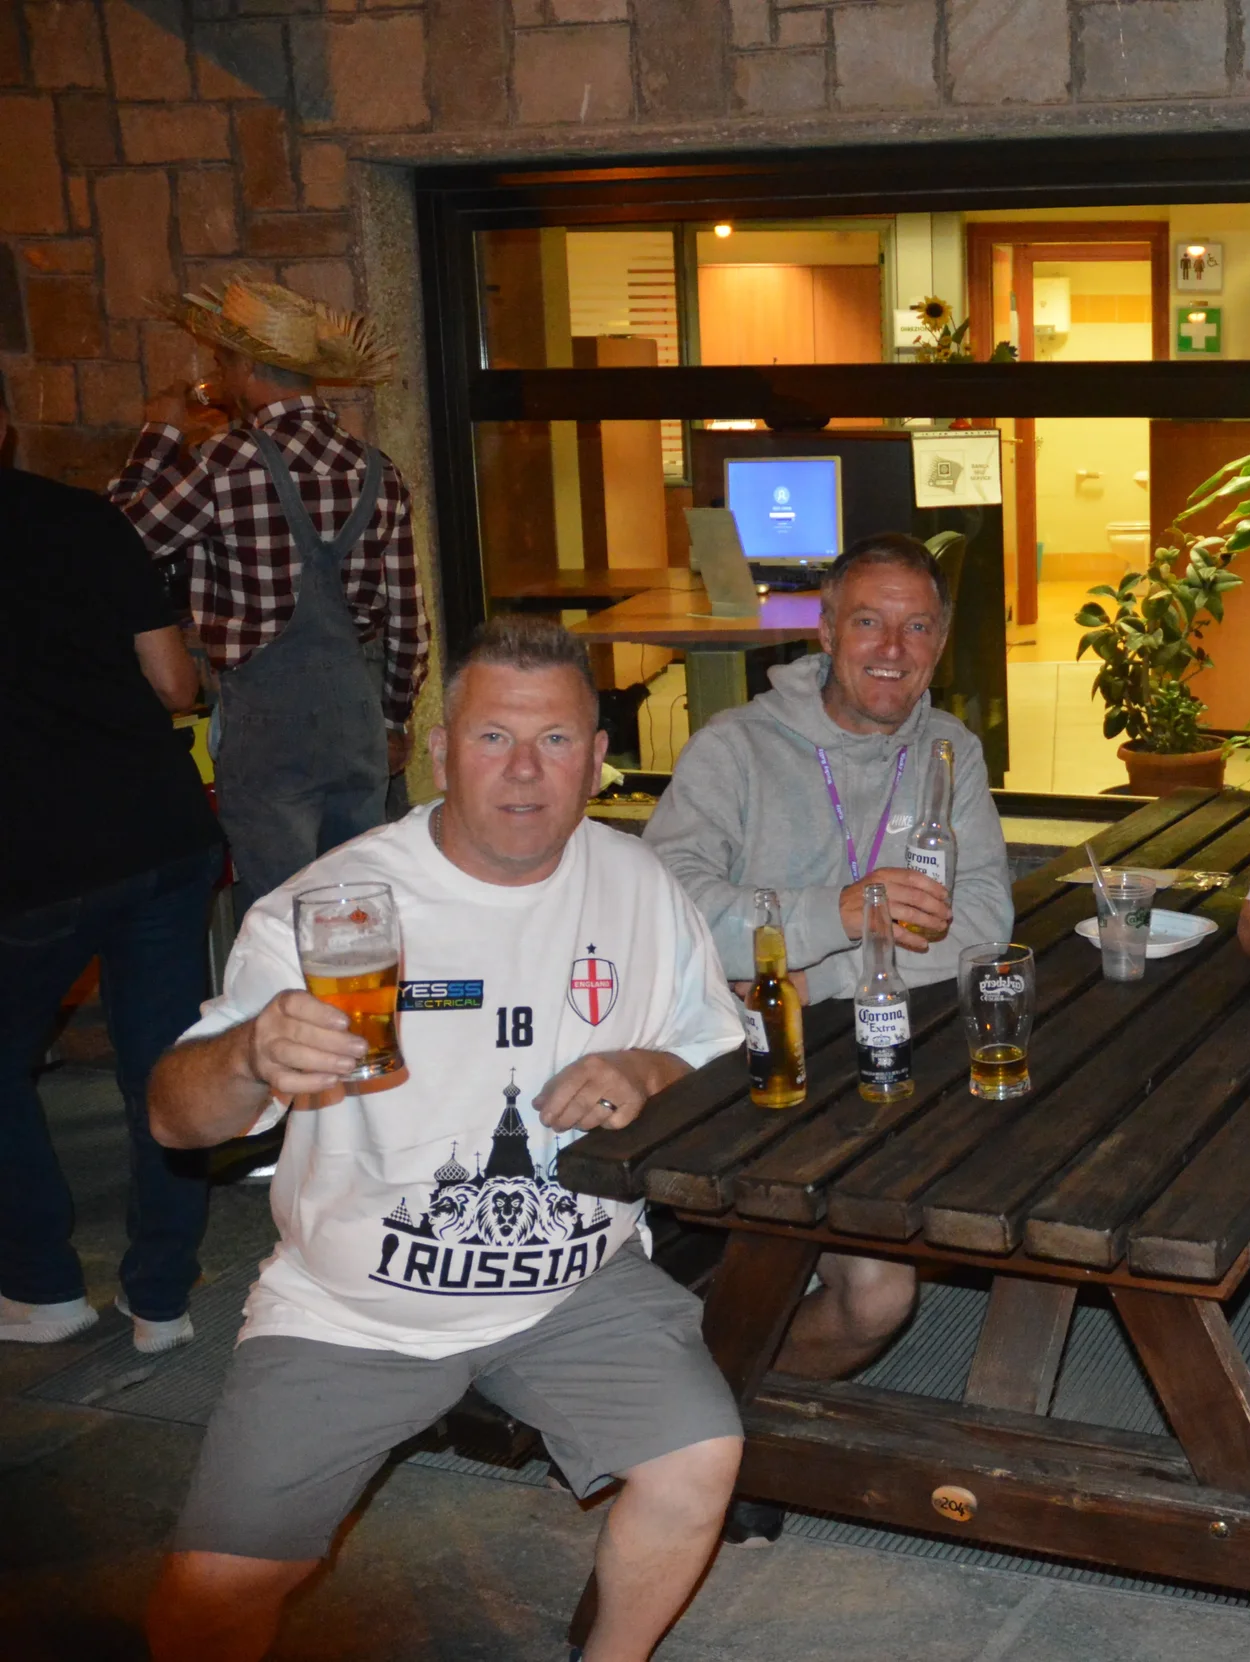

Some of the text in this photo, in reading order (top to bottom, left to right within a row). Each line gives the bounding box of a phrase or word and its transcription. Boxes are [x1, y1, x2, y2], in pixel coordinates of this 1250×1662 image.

[891, 815, 913, 826] NIKE
[398, 983, 481, 998] YESSS
[404, 999, 480, 1009] LECTRICAL
[496, 1006, 534, 1048] 18
[868, 1023, 896, 1033] Extra
[403, 1241, 588, 1288] RUSSIA
[941, 1496, 965, 1517] 204
